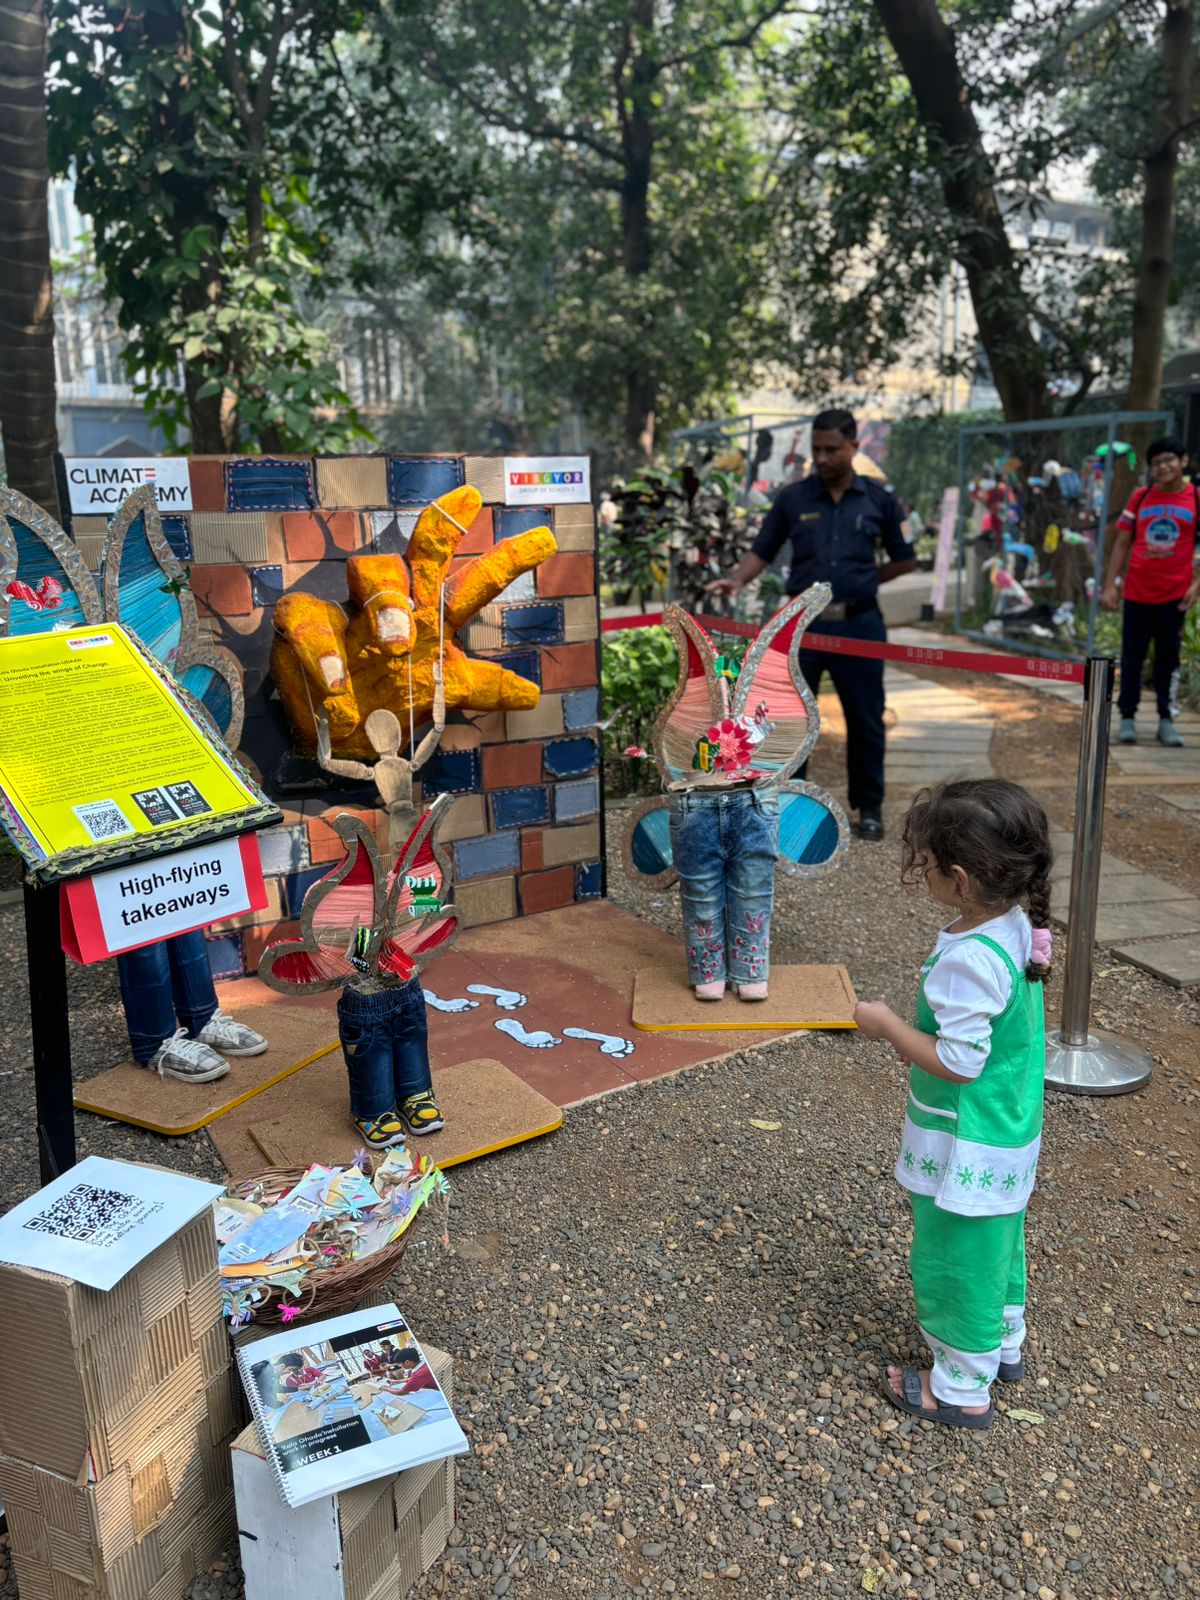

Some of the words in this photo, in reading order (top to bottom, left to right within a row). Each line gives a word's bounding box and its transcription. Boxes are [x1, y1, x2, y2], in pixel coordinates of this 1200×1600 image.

[70, 468, 156, 484] CLIMATE
[511, 472, 582, 485] VIBGYOR
[90, 487, 188, 503] ACAMY
[120, 859, 222, 897] High-flying
[121, 883, 230, 926] takeaways
[85, 1230, 105, 1245] Scan
[105, 1224, 136, 1247] creative
[282, 1446, 299, 1456] work
[308, 1433, 338, 1447] progress
[297, 1448, 332, 1466] WEEK
[333, 1445, 342, 1453] 1
